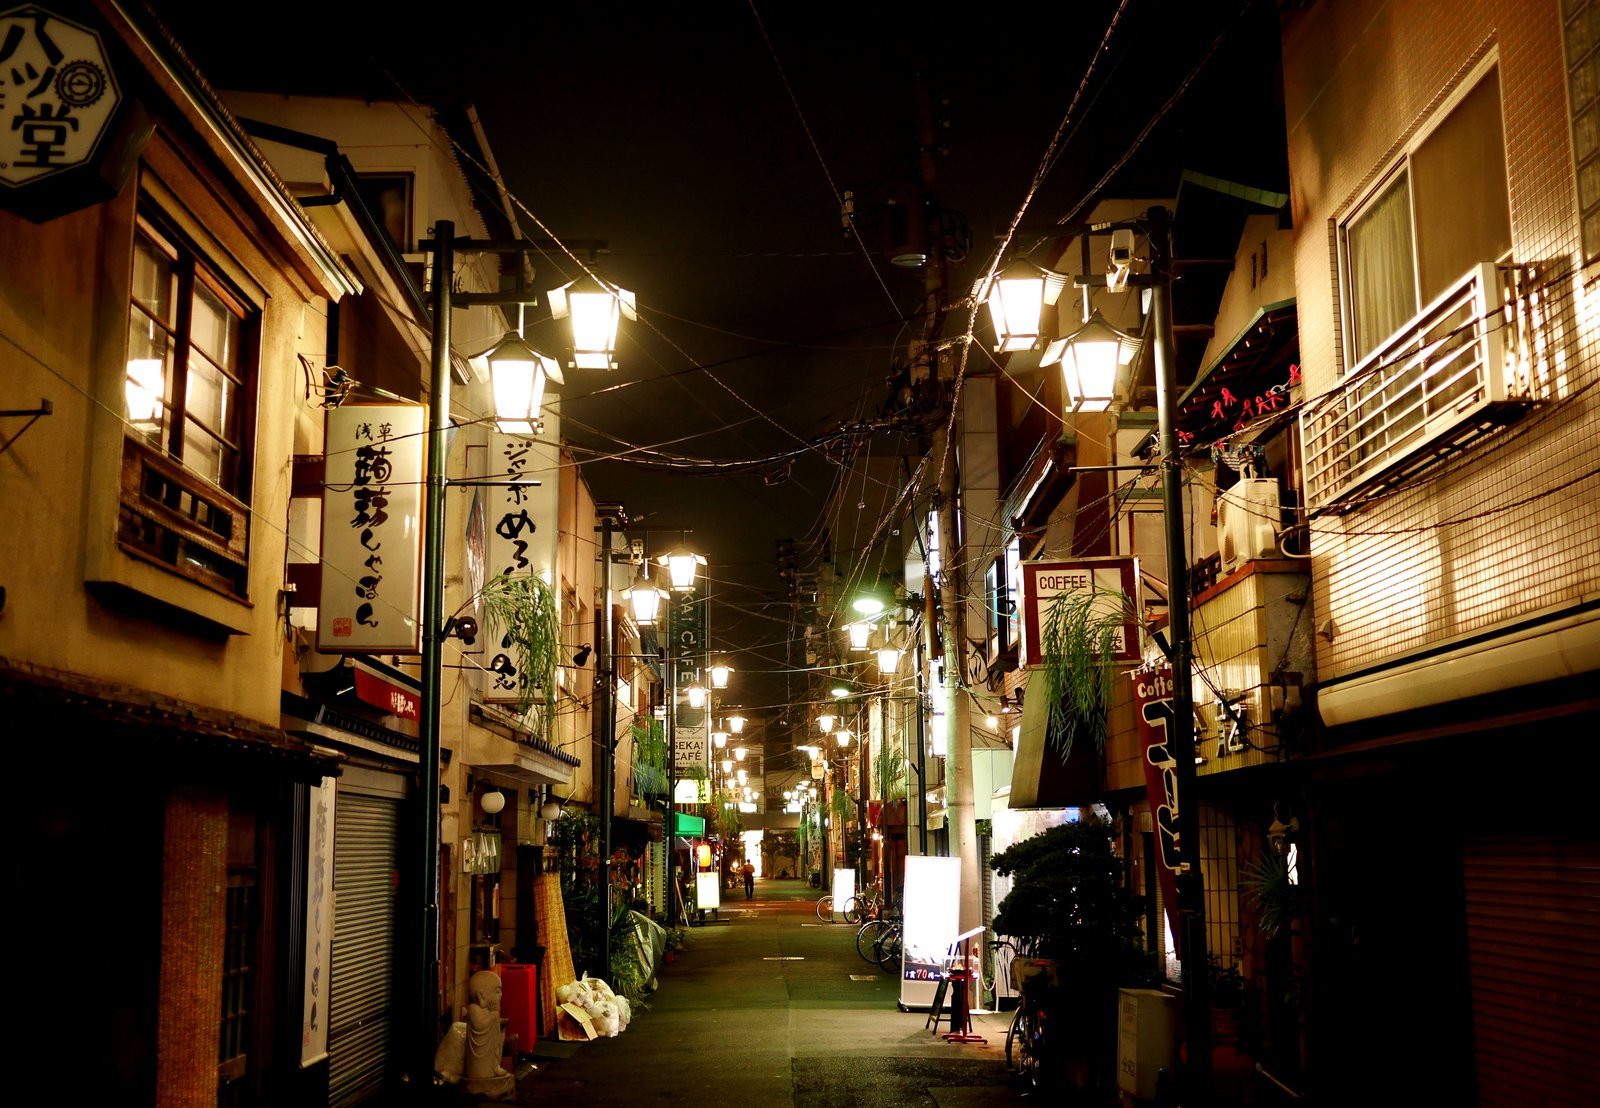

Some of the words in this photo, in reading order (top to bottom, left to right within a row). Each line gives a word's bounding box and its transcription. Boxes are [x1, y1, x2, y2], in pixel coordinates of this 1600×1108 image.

[355, 422, 394, 442] 浅草
[1039, 575, 1087, 590] COFFEE
[1137, 676, 1174, 699] Coffe
